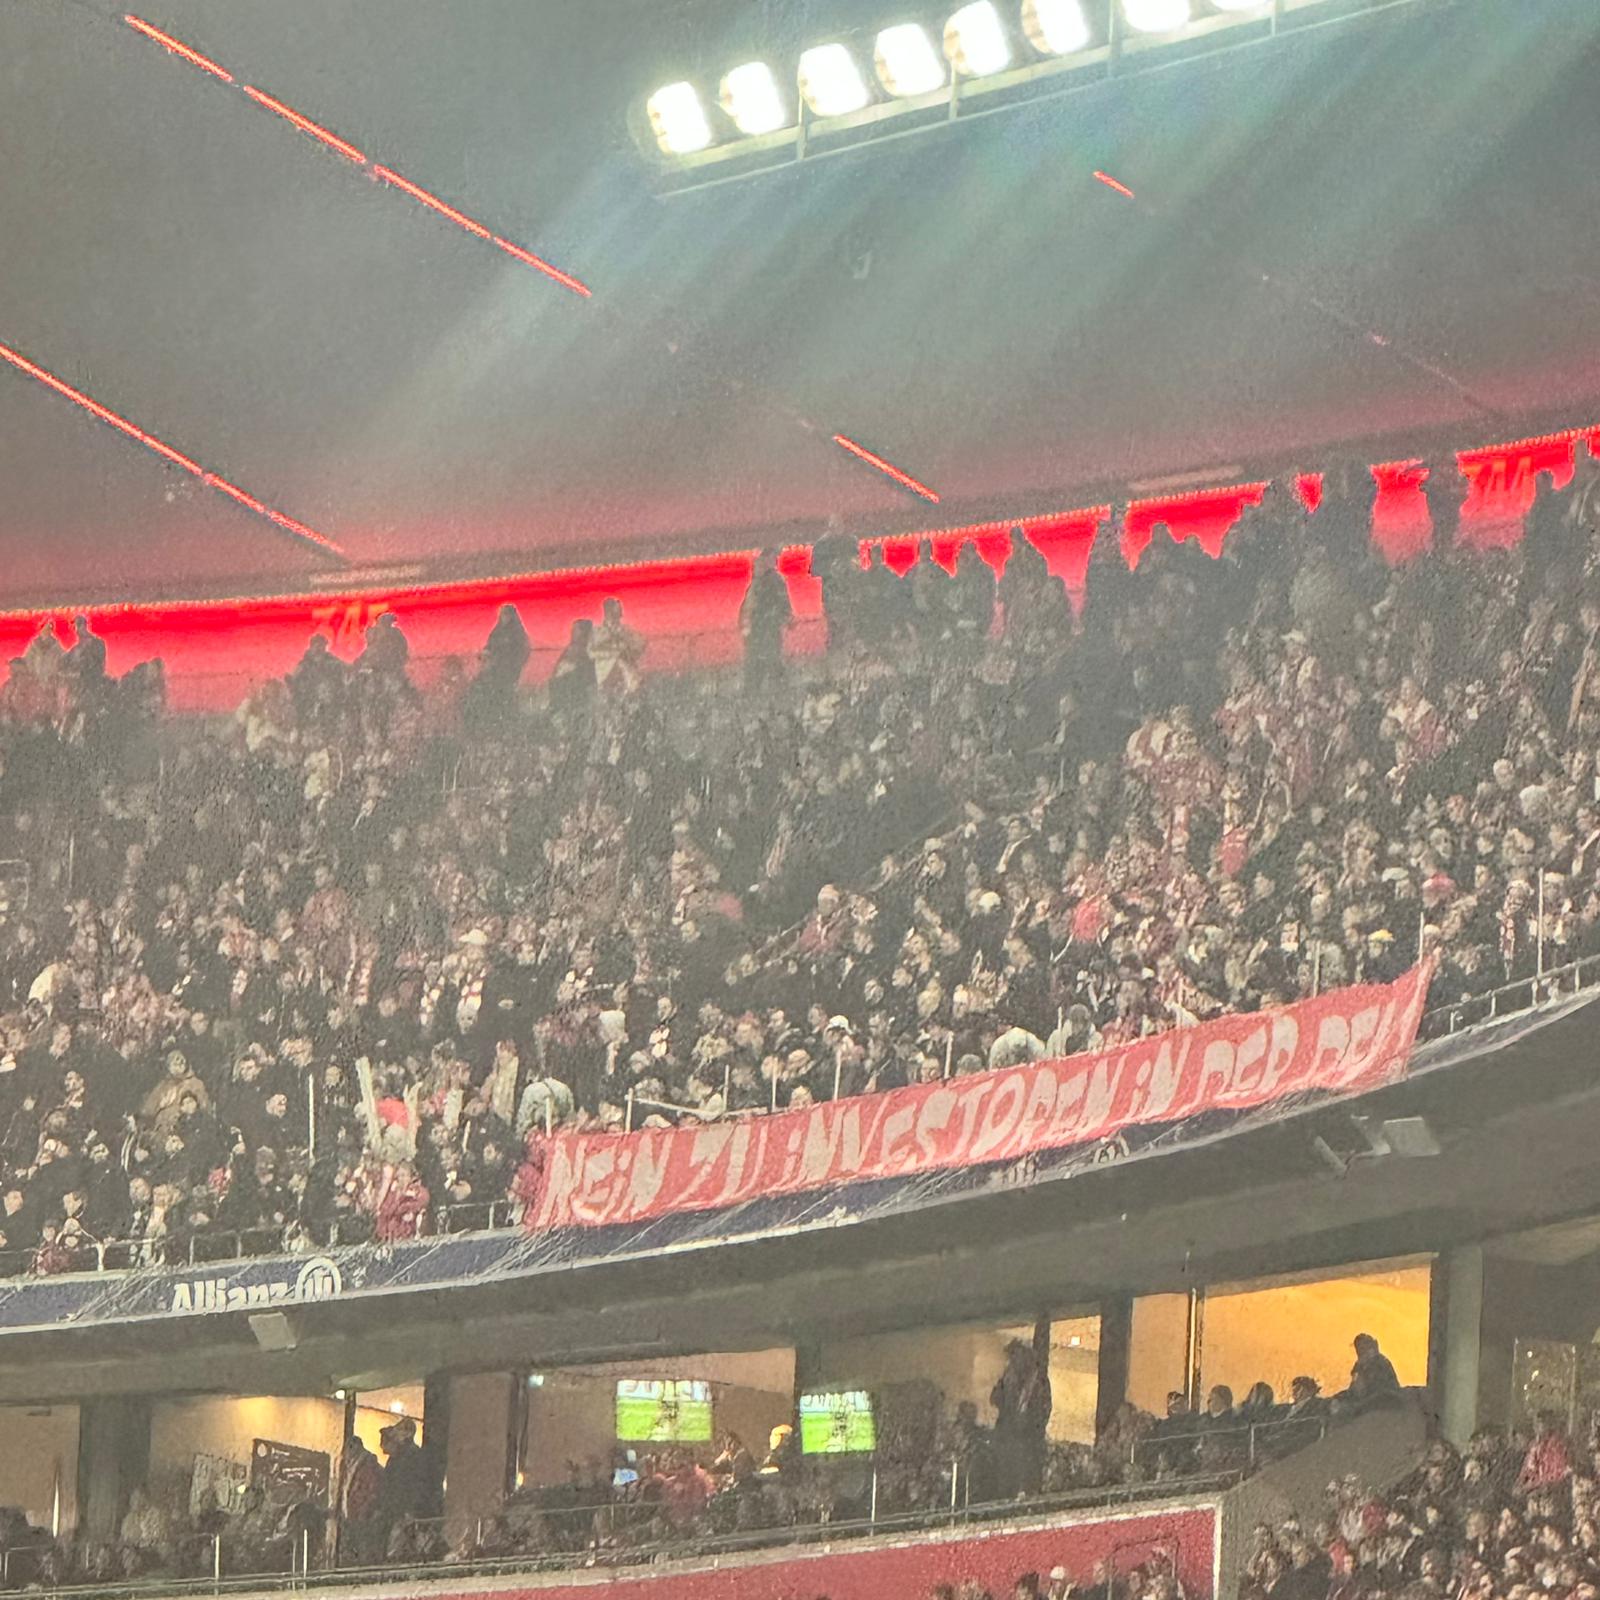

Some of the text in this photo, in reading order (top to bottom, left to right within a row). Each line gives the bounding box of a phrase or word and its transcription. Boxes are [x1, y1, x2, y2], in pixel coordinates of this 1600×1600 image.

[672, 1121, 769, 1208] ZU
[1185, 1013, 1299, 1112] DER
[171, 1277, 289, 1313] Allianz
